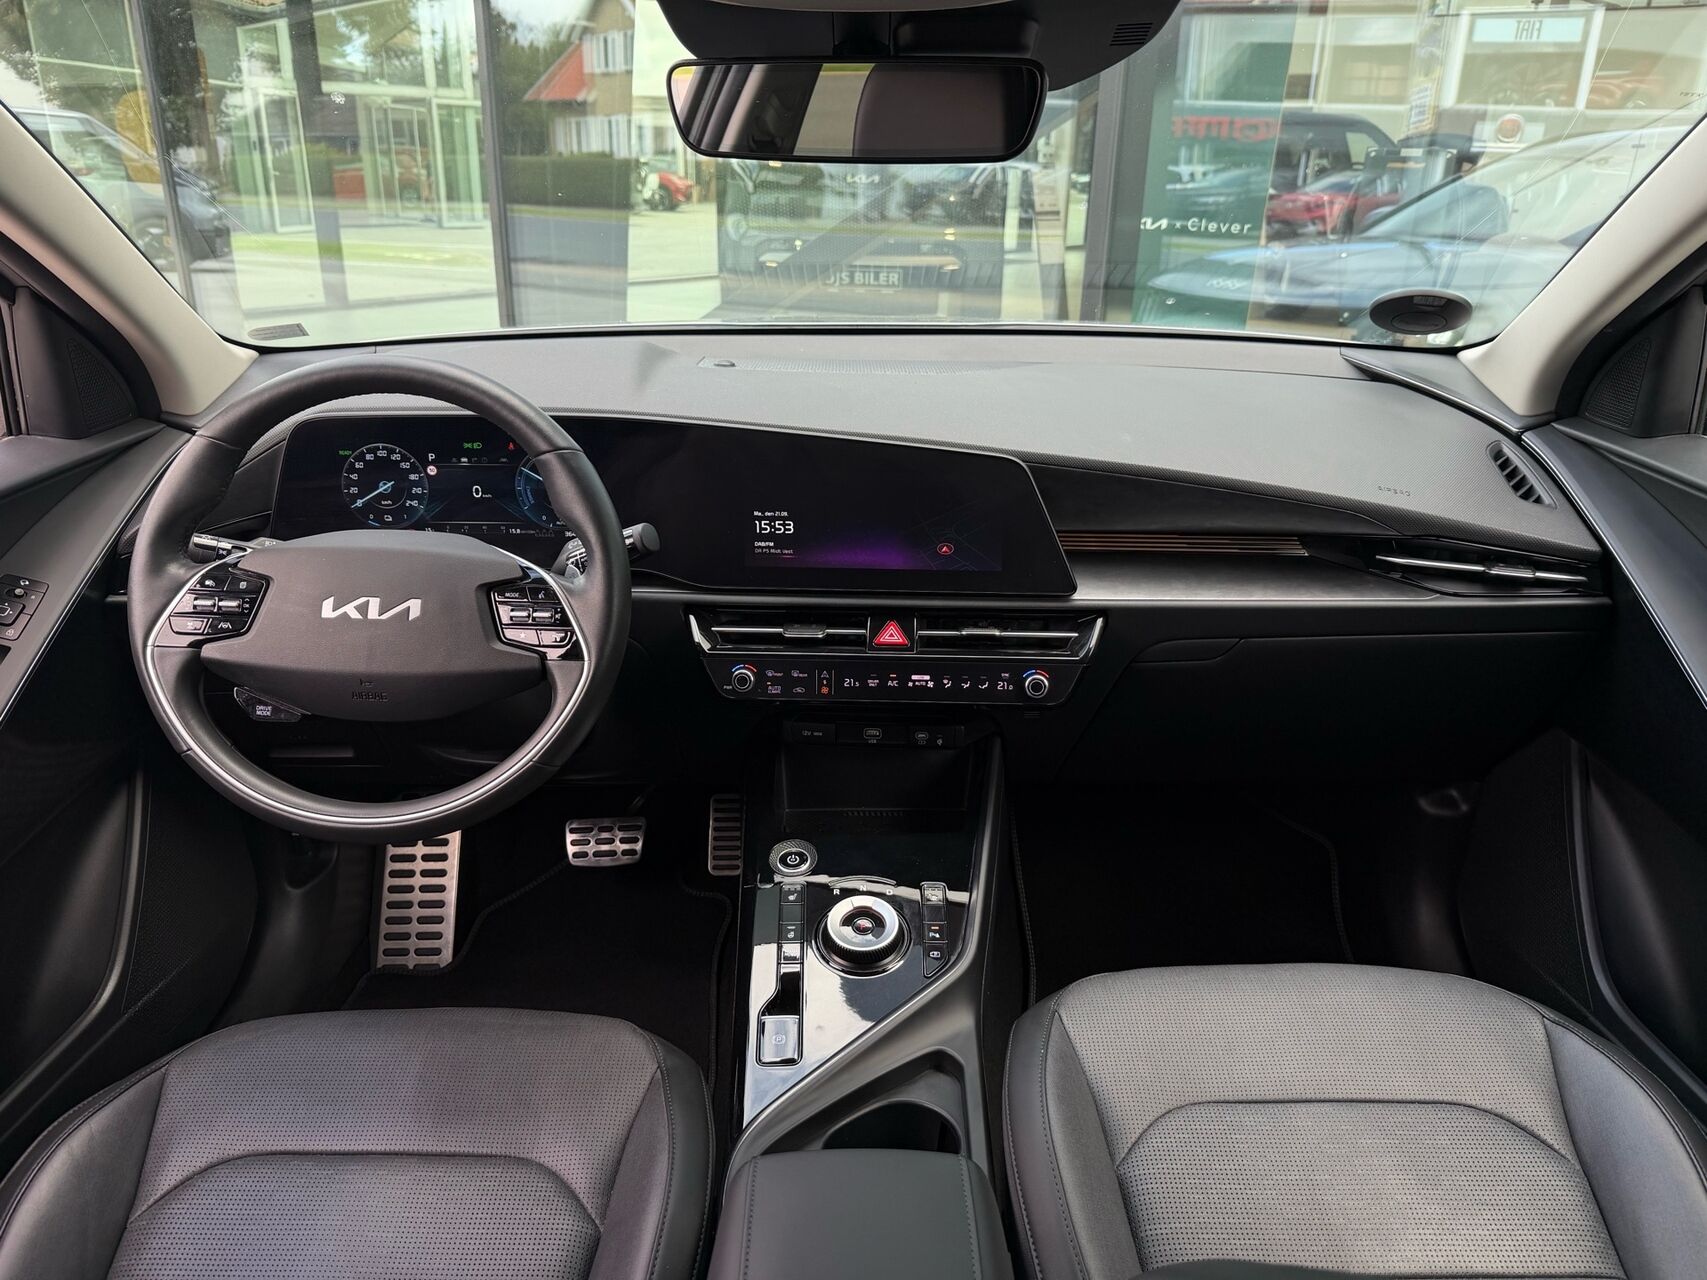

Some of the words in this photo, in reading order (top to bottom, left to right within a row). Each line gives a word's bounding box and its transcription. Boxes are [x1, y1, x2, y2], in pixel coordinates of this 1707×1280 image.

[1187, 217, 1252, 234] Clever
[854, 271, 899, 286] BILER
[428, 453, 435, 462] P
[472, 485, 482, 498] 0
[755, 520, 795, 534] 15:53
[321, 595, 422, 621] KIA
